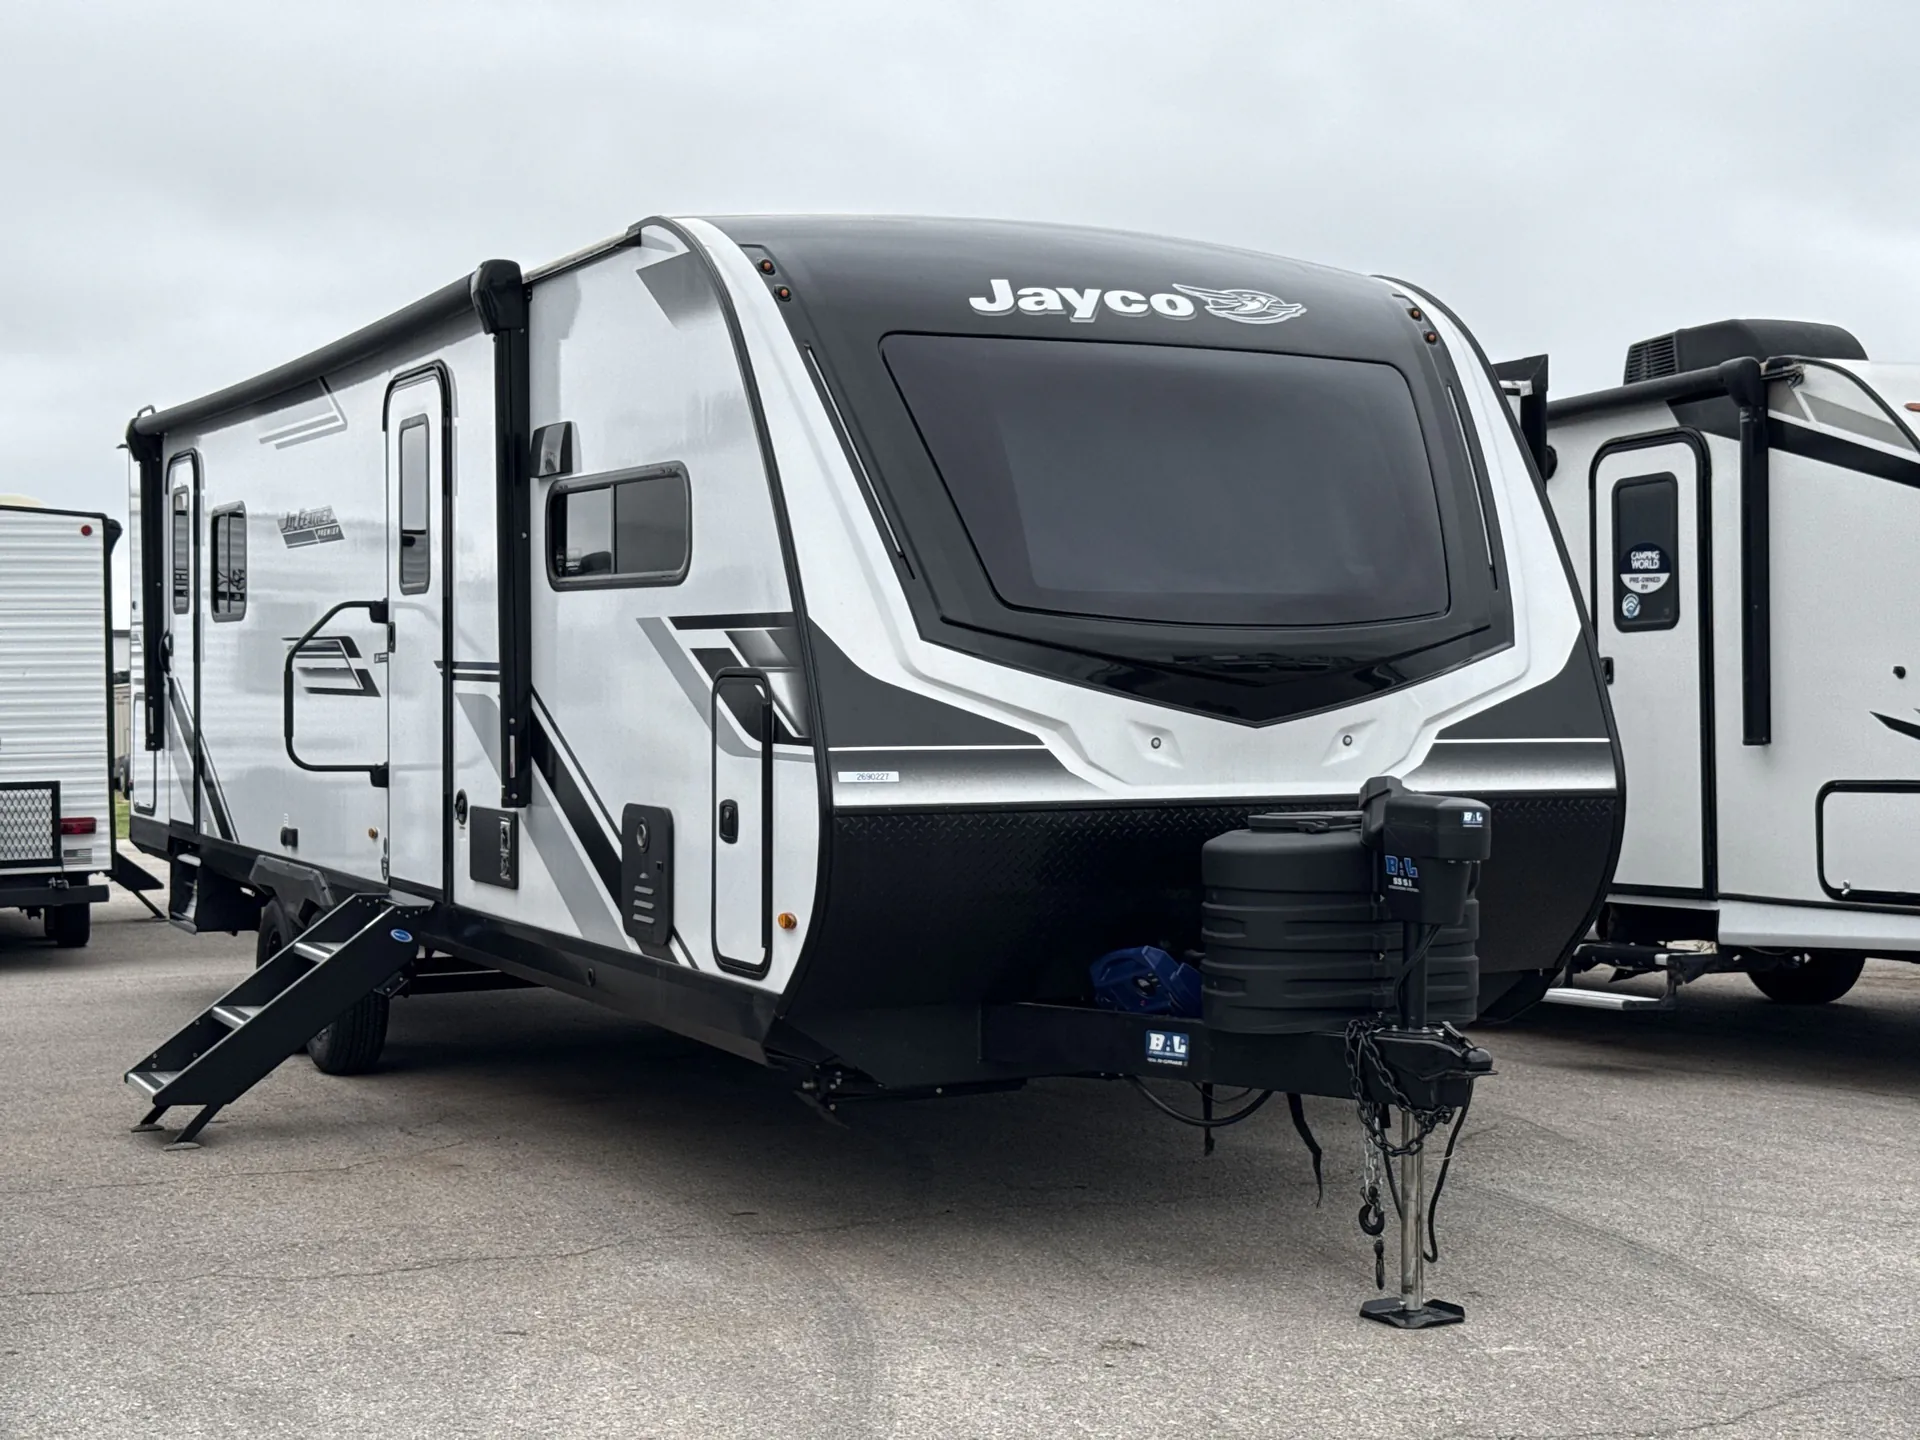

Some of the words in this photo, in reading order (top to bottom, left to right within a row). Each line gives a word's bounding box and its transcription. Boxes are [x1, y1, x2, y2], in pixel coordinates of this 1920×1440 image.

[969, 279, 1197, 322] Jayco
[1630, 551, 1660, 560] CAMPING
[1631, 560, 1660, 570] WORLD
[856, 773, 889, 781] 2690227
